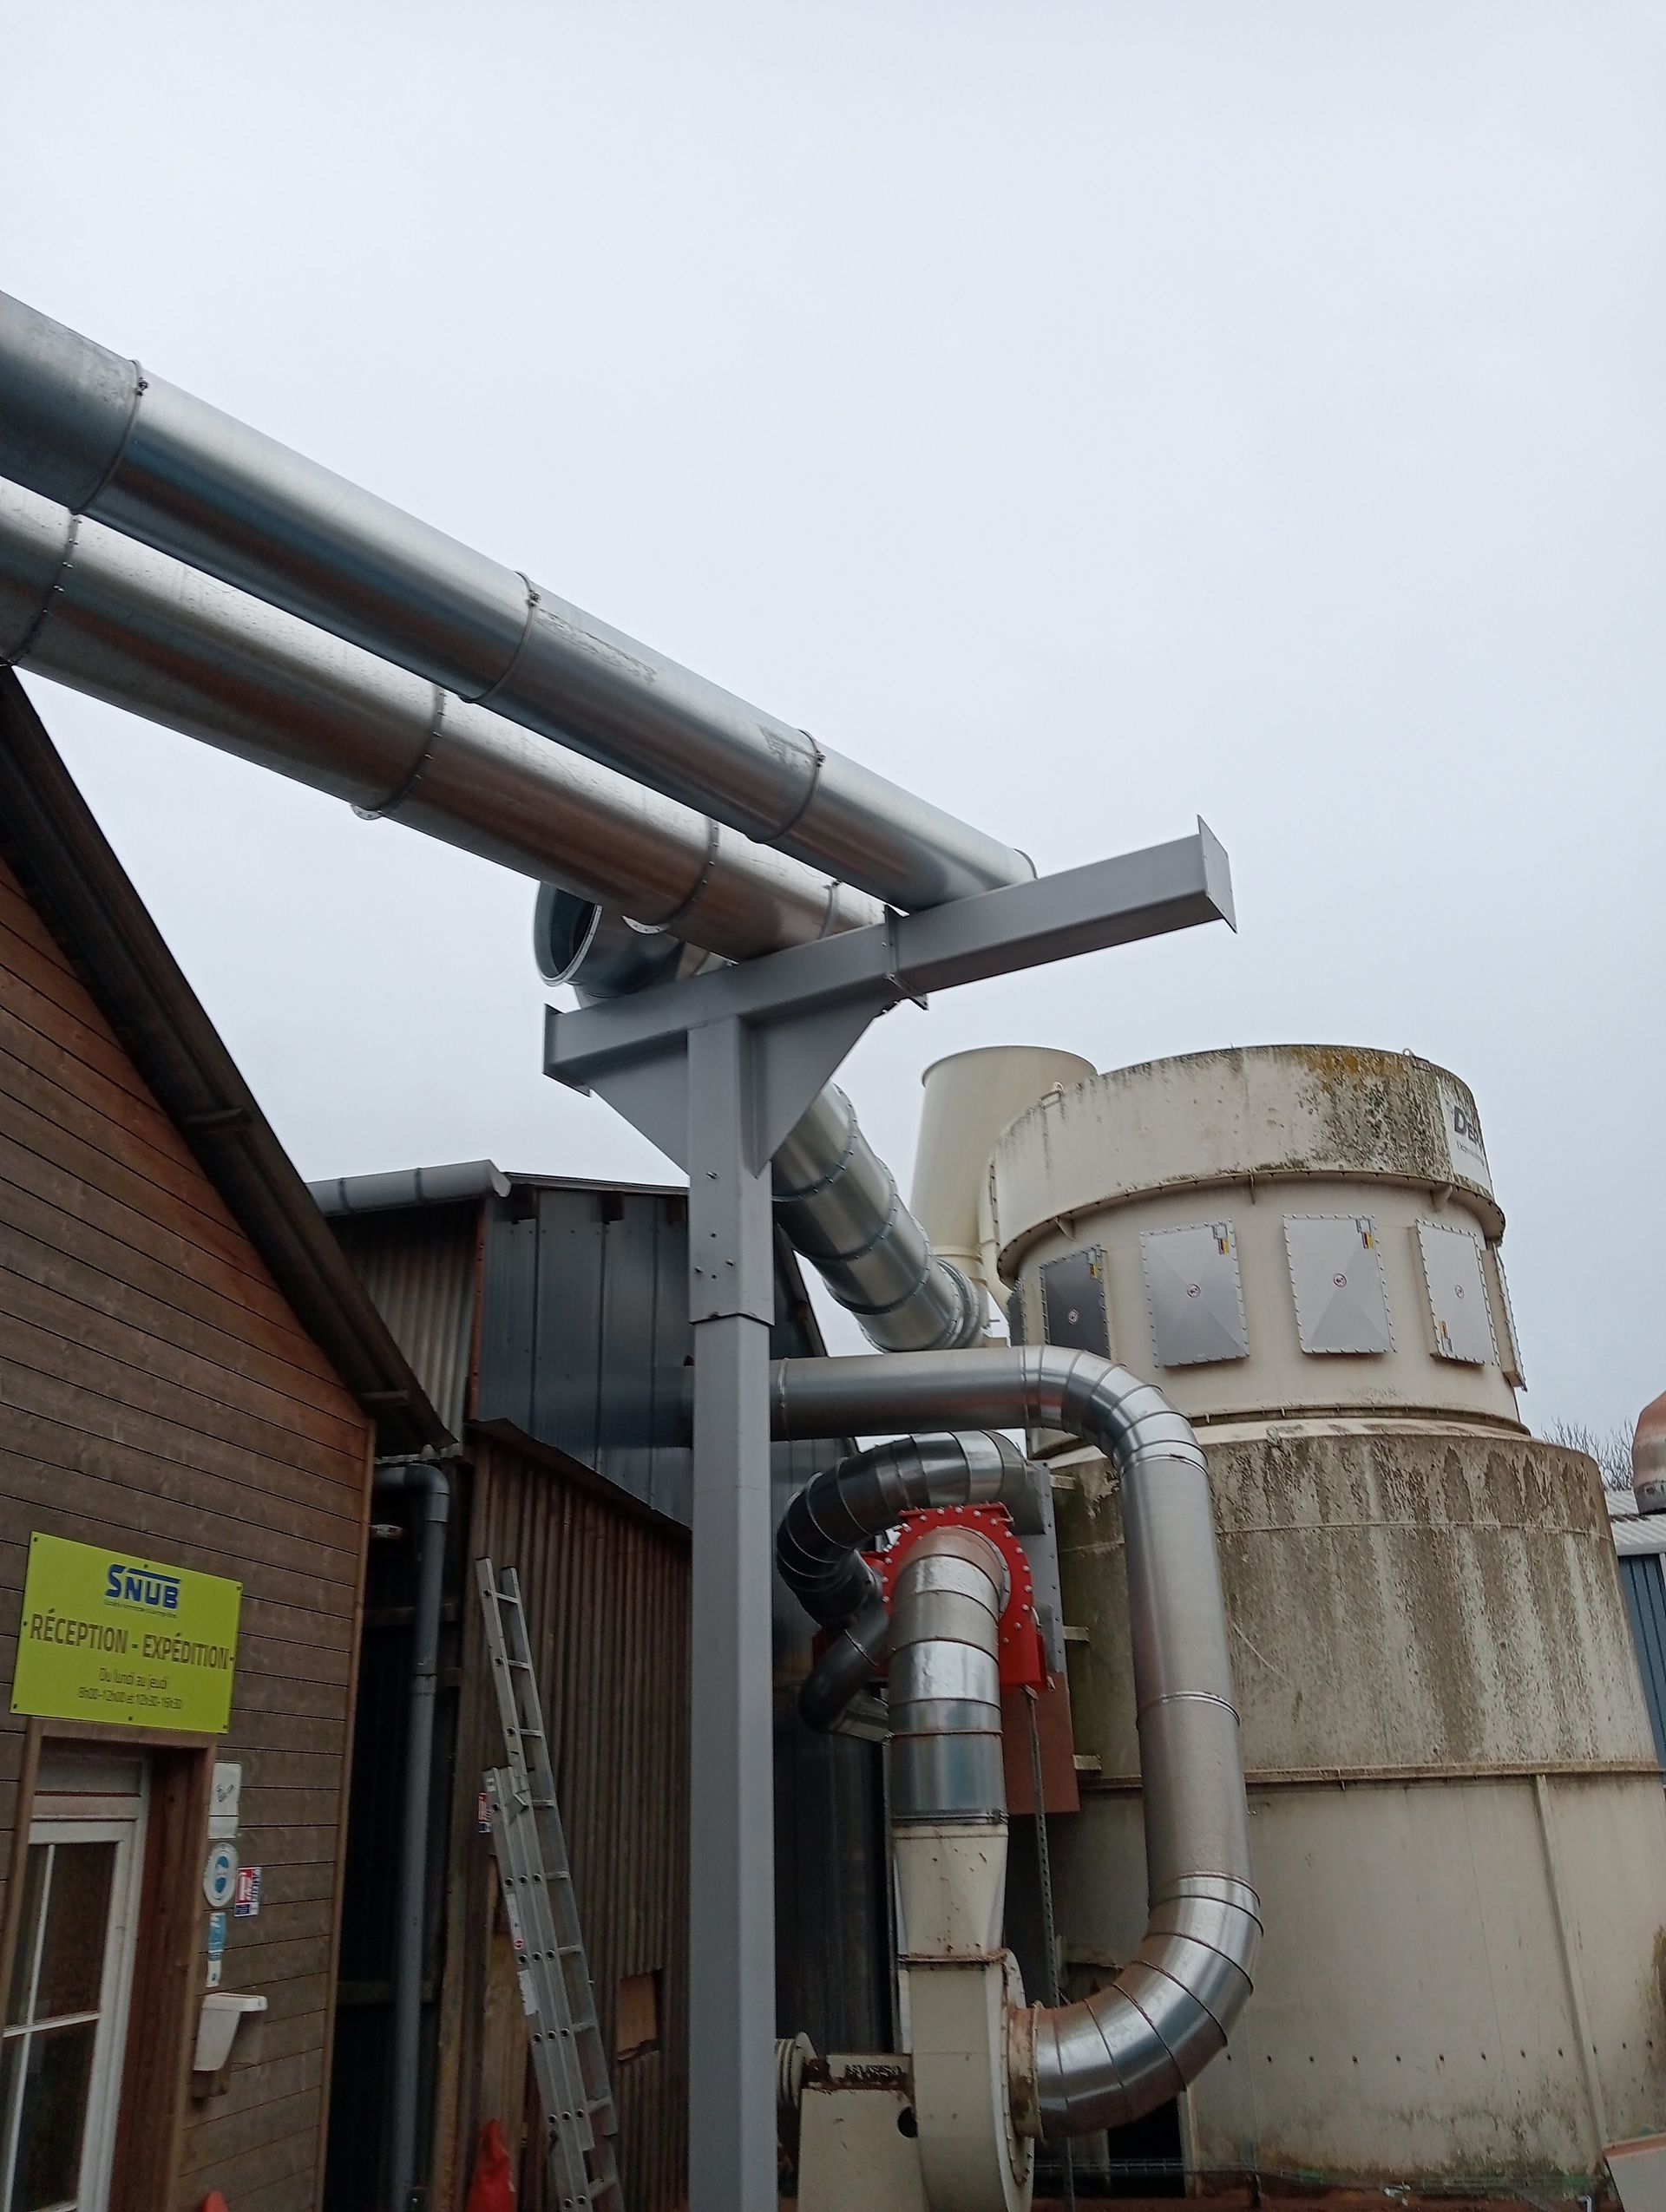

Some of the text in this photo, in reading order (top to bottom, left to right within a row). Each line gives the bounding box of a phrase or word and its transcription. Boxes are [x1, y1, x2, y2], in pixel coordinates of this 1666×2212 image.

[105, 1564, 180, 1610] SNUB
[30, 1609, 128, 1654] RÉCEPTION
[142, 1633, 230, 1670] EXPÉDITION
